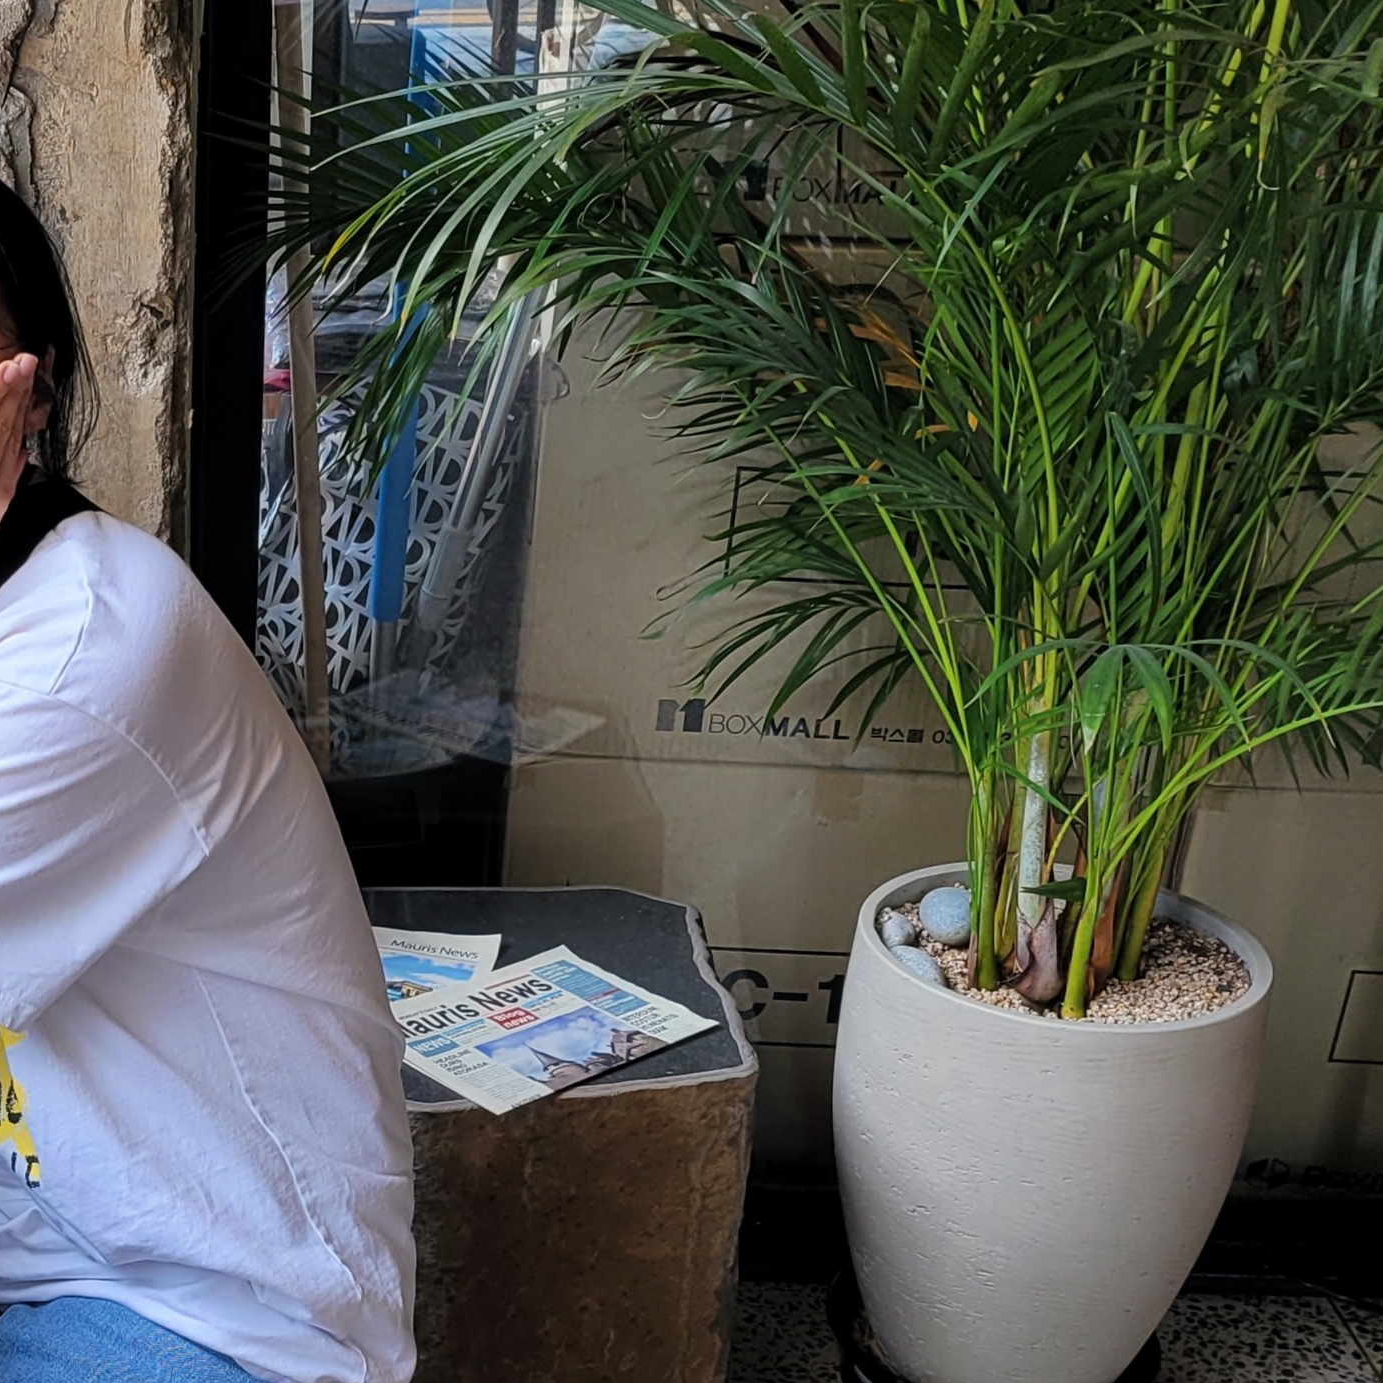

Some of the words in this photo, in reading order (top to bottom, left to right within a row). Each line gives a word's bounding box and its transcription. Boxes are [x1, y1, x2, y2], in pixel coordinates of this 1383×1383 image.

[390, 939, 437, 954] Mauris
[439, 946, 479, 960] News
[467, 979, 553, 1011] News
[493, 1009, 526, 1022] Blog
[503, 1015, 535, 1029] news
[412, 1037, 452, 1053] NEWS
